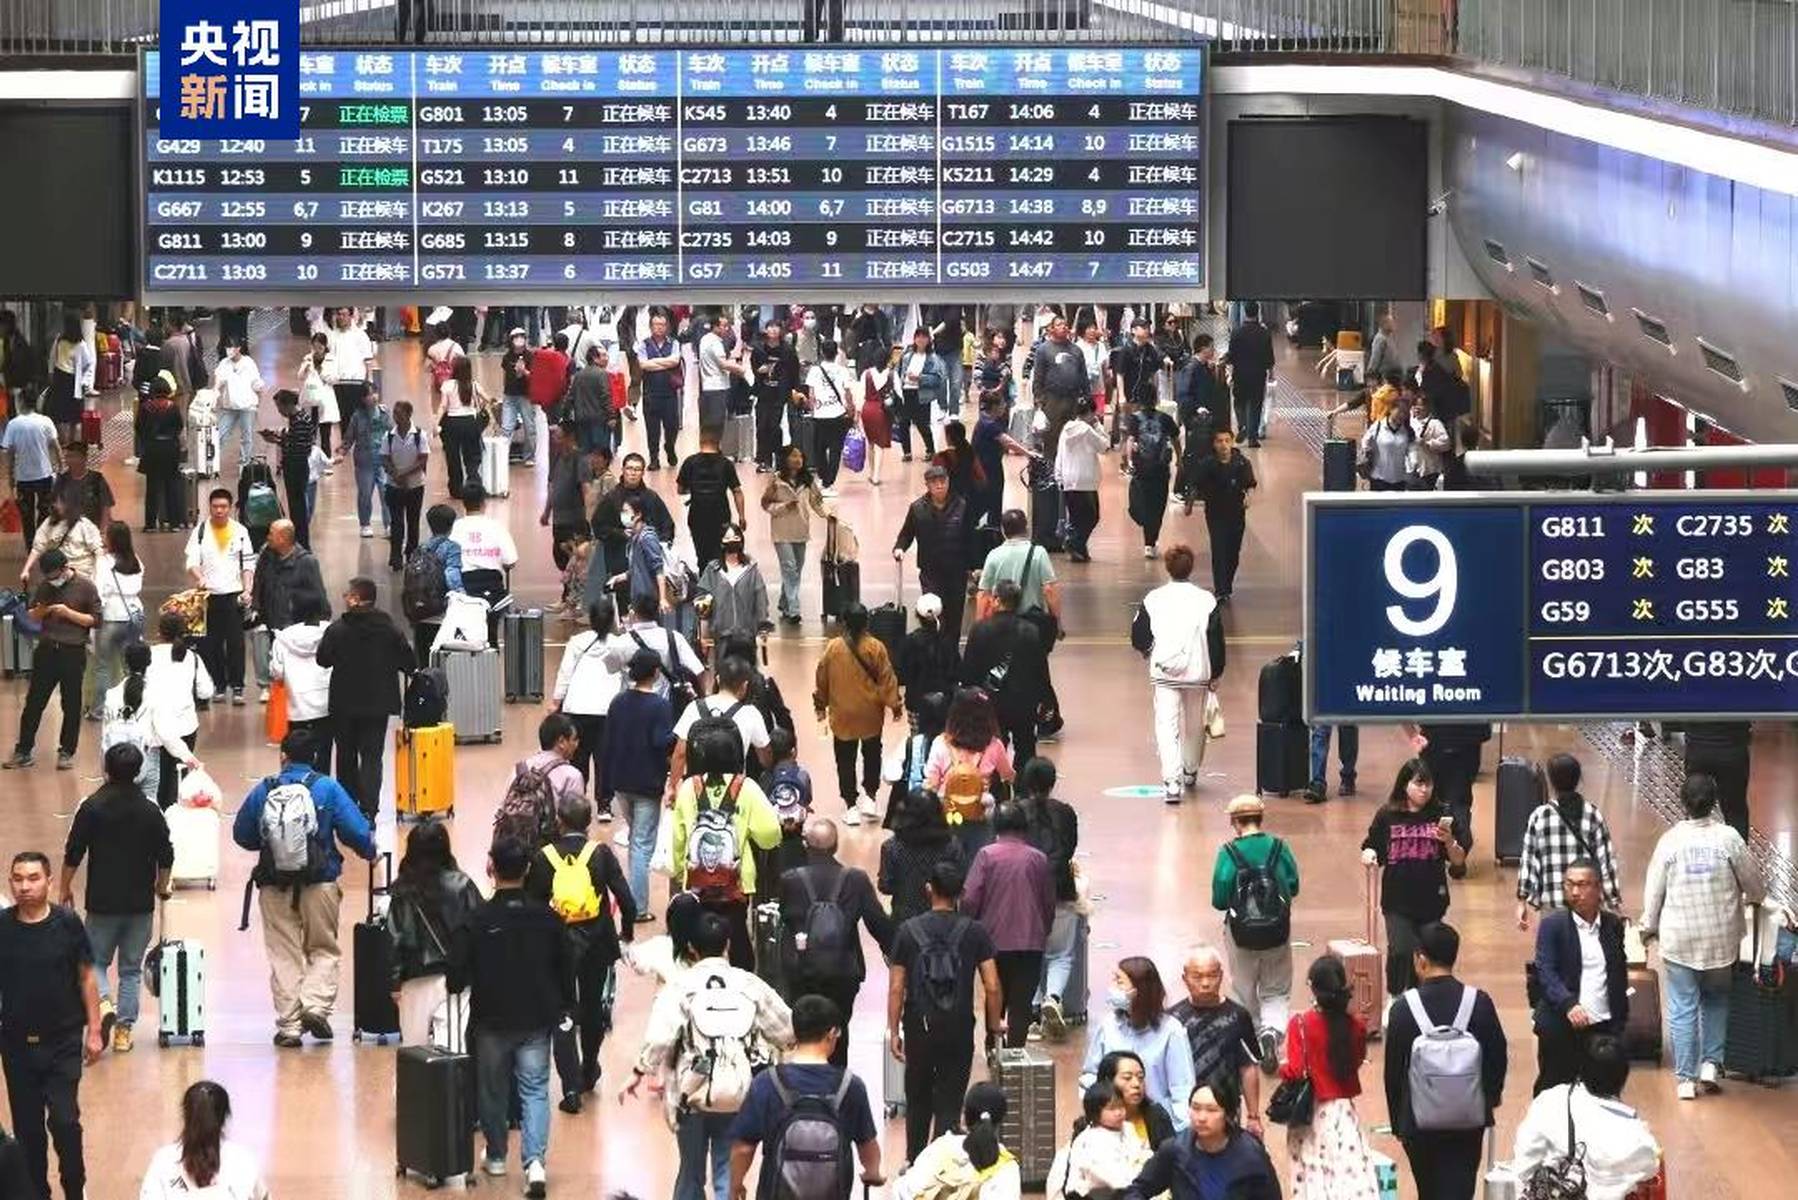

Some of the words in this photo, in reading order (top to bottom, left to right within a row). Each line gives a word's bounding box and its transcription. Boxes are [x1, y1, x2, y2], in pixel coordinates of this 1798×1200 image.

[300, 55, 334, 74] 车室
[355, 55, 393, 74] 状态
[426, 55, 462, 74] 车次
[488, 55, 526, 74] 开点
[541, 55, 598, 74] 候车室
[618, 55, 656, 74] 状态
[689, 54, 725, 73] 车次
[752, 54, 789, 73] 开点
[804, 53, 860, 73] 候车室
[881, 53, 919, 72] 状态
[951, 53, 988, 71] 车次
[1014, 53, 1051, 71] 开点
[1067, 53, 1123, 71] 候车室
[1144, 53, 1181, 71] 状态
[353, 80, 394, 91] Status
[427, 80, 458, 91] Train
[491, 80, 520, 91] Time
[617, 80, 657, 91] Status
[691, 79, 721, 90] Train
[754, 79, 784, 90] Time
[881, 79, 920, 89] Status
[953, 78, 985, 89] Train
[1017, 78, 1047, 89] Time
[1145, 78, 1183, 89] Status
[300, 106, 310, 122] 7
[340, 105, 408, 123] 正在检票
[420, 106, 464, 122] G801
[483, 106, 527, 121] 13:05
[563, 106, 573, 121] 7
[602, 104, 671, 122] 正在候车
[685, 105, 726, 120] K545
[747, 105, 791, 120] 13:40
[825, 105, 837, 120] 4
[866, 103, 934, 120] 正在候车
[948, 104, 989, 119] T167
[1010, 104, 1054, 119] 14:06
[1088, 104, 1100, 118] 4
[1129, 103, 1197, 120] 正在候车
[156, 140, 200, 153] G429
[220, 140, 265, 153] 12:40
[295, 138, 315, 153] 11
[339, 136, 408, 154] 正在候车
[421, 139, 462, 153] T175
[484, 138, 528, 152] 13:05
[563, 138, 574, 152] 4
[603, 135, 671, 153] 正在候车
[684, 138, 727, 152] G673
[747, 136, 791, 151] 13:46
[826, 136, 836, 150] 7
[866, 134, 934, 152] 正在候车
[942, 136, 995, 151] G1515
[1010, 135, 1053, 150] 14:14
[1085, 135, 1105, 150] 10
[1129, 133, 1197, 151] 正在候车
[154, 169, 205, 185] K1115
[221, 170, 265, 185] 12:53
[301, 169, 310, 184] 5
[340, 168, 409, 186] 正在检票
[421, 169, 464, 185] G521
[484, 169, 528, 184] 13:10
[559, 170, 579, 184] 11
[603, 168, 671, 185] 正在候车
[681, 168, 731, 183] C2713
[747, 168, 791, 183] 13:51
[822, 168, 842, 182] 10
[866, 166, 934, 184] 正在候车
[943, 168, 994, 182] K5211
[1010, 167, 1053, 182] 14:29
[1088, 167, 1100, 182] 4
[1129, 166, 1197, 183] 正在候车
[158, 202, 202, 217] G667
[221, 202, 265, 217] 12:55
[294, 202, 318, 219] 6,7
[340, 200, 409, 218] 正在候车
[423, 201, 463, 217] K267
[484, 201, 528, 217] 13:13
[565, 201, 575, 216] 5
[603, 200, 672, 217] 正在候车
[689, 201, 723, 215] G81
[748, 200, 791, 215] 14:00
[819, 200, 844, 217] 6,7
[866, 198, 934, 216] 正在候车
[942, 199, 994, 214] G6713
[1010, 199, 1054, 214] 14:38
[1082, 200, 1106, 216] 8,9
[1128, 198, 1197, 215] 正在候车
[159, 234, 202, 248] G811
[222, 233, 266, 248] 13:00
[301, 233, 312, 247] 9
[340, 231, 409, 249] 正在候车
[421, 234, 465, 248] G685
[485, 233, 528, 247] 13:15
[564, 233, 575, 247] 8
[604, 230, 672, 248] 正在候车
[681, 232, 732, 247] C2735
[747, 231, 791, 246] 14:03
[826, 231, 837, 245] 9
[866, 229, 934, 246] 正在候车
[942, 231, 994, 246] C2715
[1010, 230, 1053, 245] 14:42
[1085, 230, 1104, 245] 10
[1128, 228, 1196, 246] 正在候车
[155, 264, 207, 280] C2711
[222, 265, 266, 280] 13:03
[297, 265, 317, 280] 10
[341, 263, 410, 280] 正在候车
[422, 264, 466, 279] G571
[485, 265, 529, 279] 13:37
[564, 264, 576, 279] 6
[604, 263, 672, 280] 正在候车
[689, 263, 723, 278] G57
[748, 263, 791, 278] 14:05
[822, 263, 842, 277] 11
[866, 261, 935, 278] 正在候车
[947, 262, 990, 277] G503
[1010, 262, 1053, 277] 14:47
[1088, 262, 1099, 277] 7
[1128, 260, 1198, 278] 正在候车
[1541, 517, 1605, 537] G811
[1632, 513, 1654, 535] 次
[1676, 515, 1753, 536] C2735
[1767, 513, 1789, 534] 次
[1542, 559, 1604, 580] G803
[1632, 557, 1654, 578] 次
[1676, 558, 1724, 579] G83
[1767, 556, 1789, 577] 次
[1384, 525, 1457, 636] 9
[1541, 601, 1590, 622] G59
[1632, 599, 1654, 620] 次
[1676, 600, 1739, 621] G555
[1767, 597, 1788, 619] 次
[1372, 647, 1466, 678] 候车室
[1356, 685, 1425, 705] Waiting
[1433, 684, 1481, 700] Room
